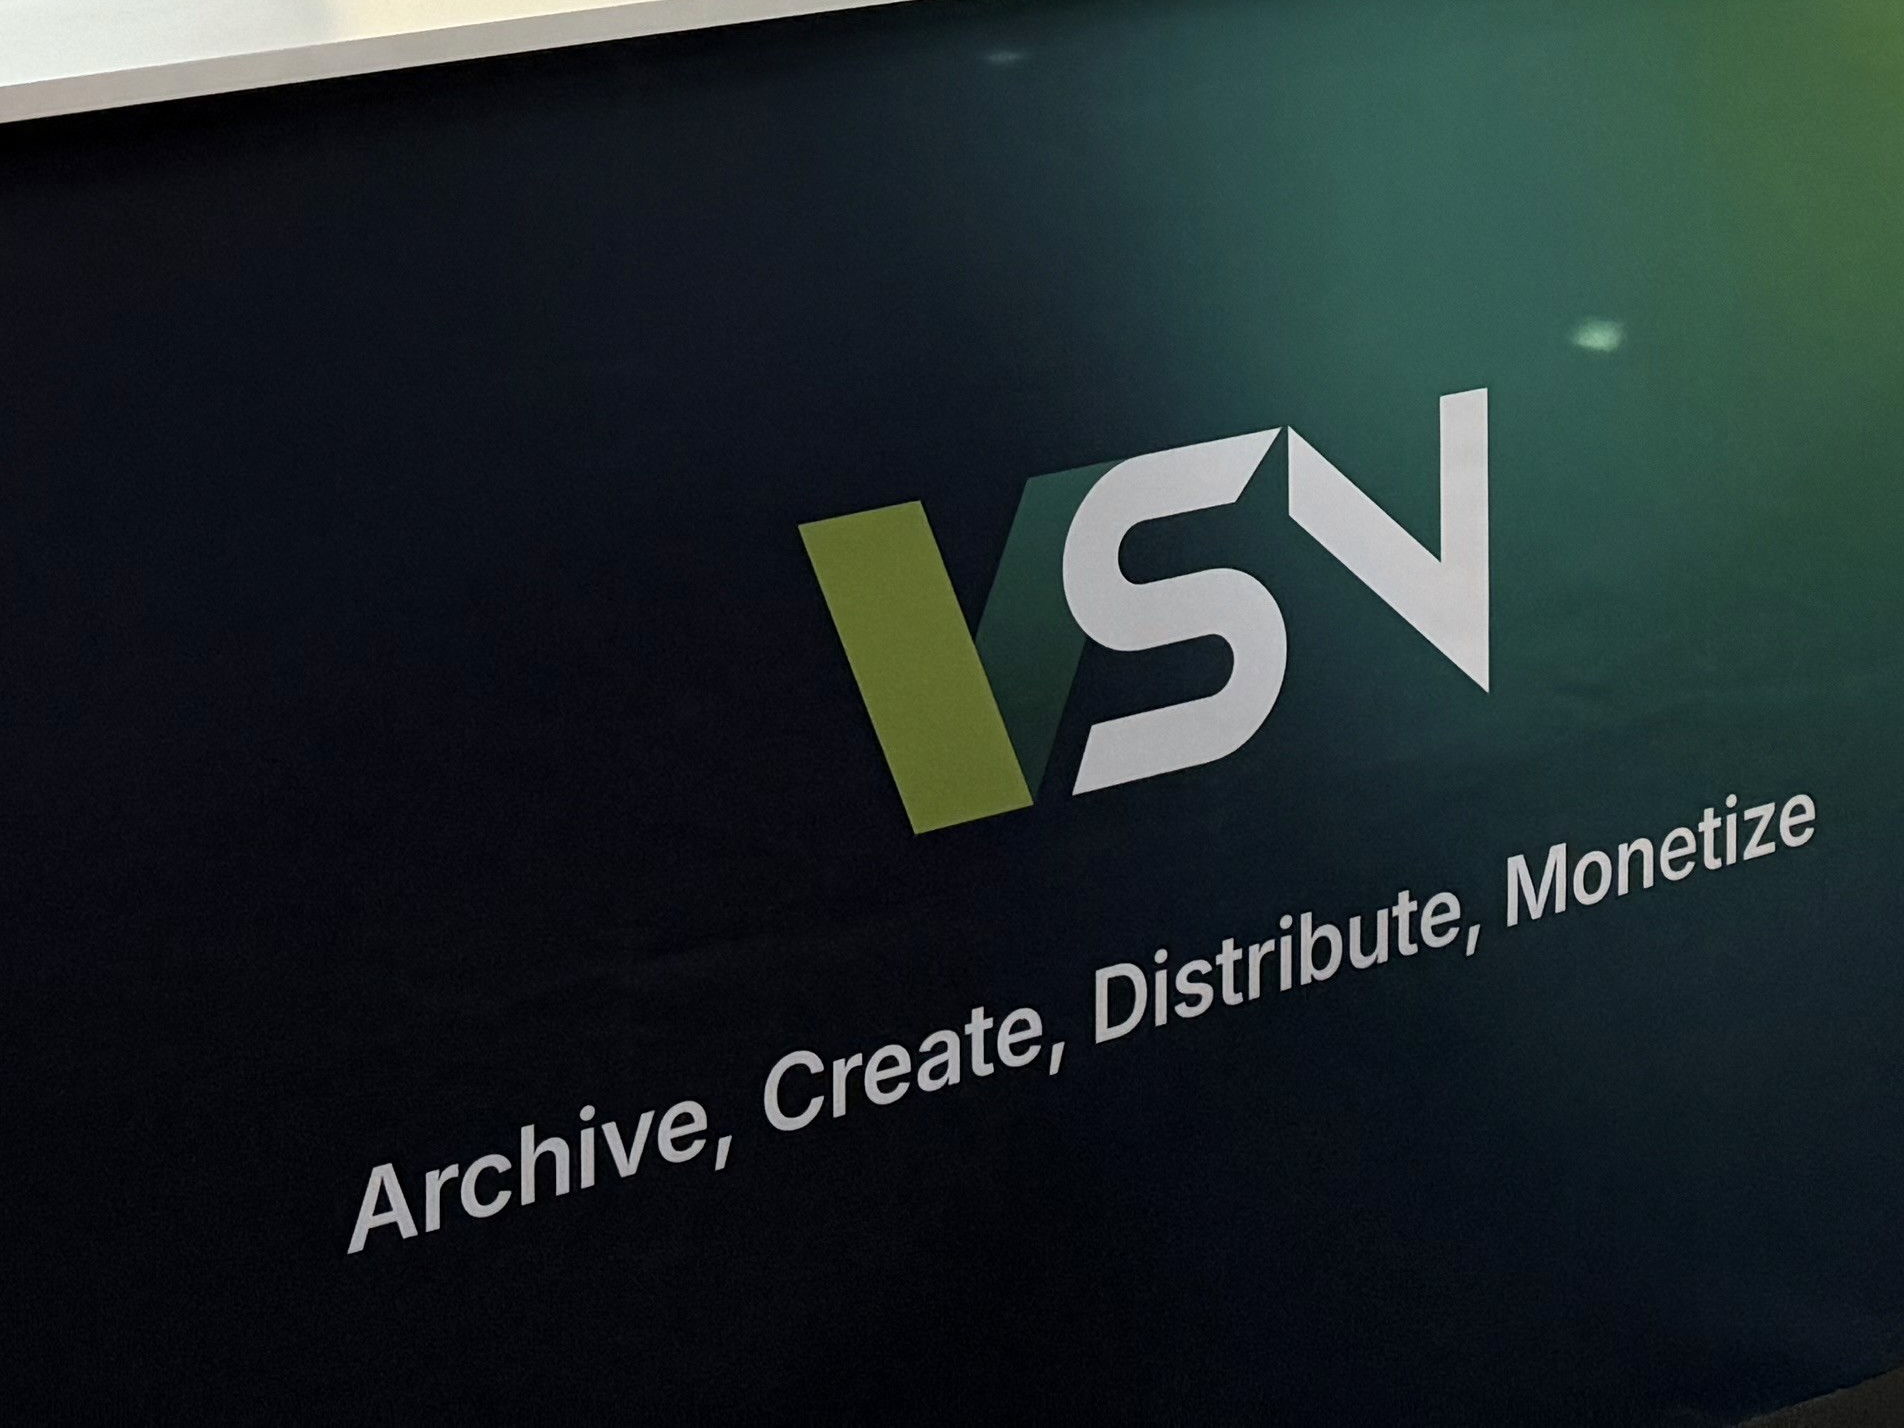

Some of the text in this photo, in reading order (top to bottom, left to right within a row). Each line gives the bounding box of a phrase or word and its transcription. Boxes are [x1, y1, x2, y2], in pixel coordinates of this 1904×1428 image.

[798, 386, 1490, 835] VSN
[346, 787, 1819, 1255] Archive, Create, Distribute, Monetize
